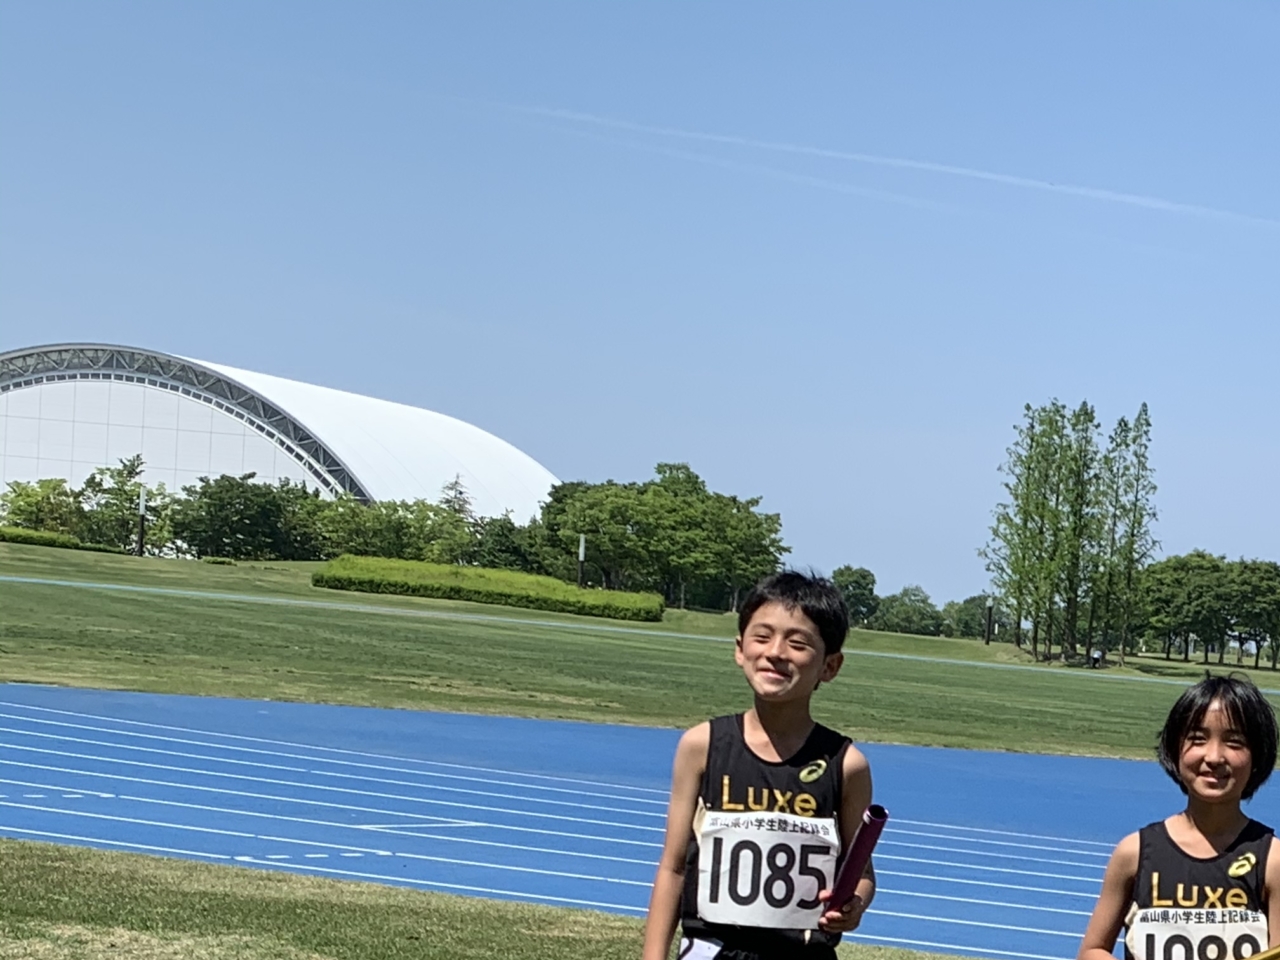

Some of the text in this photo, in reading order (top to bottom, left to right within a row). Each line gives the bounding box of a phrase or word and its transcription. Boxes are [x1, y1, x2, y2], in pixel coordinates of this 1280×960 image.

[722, 774, 817, 817] Luxe
[709, 837, 831, 910] 1085
[1151, 872, 1248, 910] Luxe
